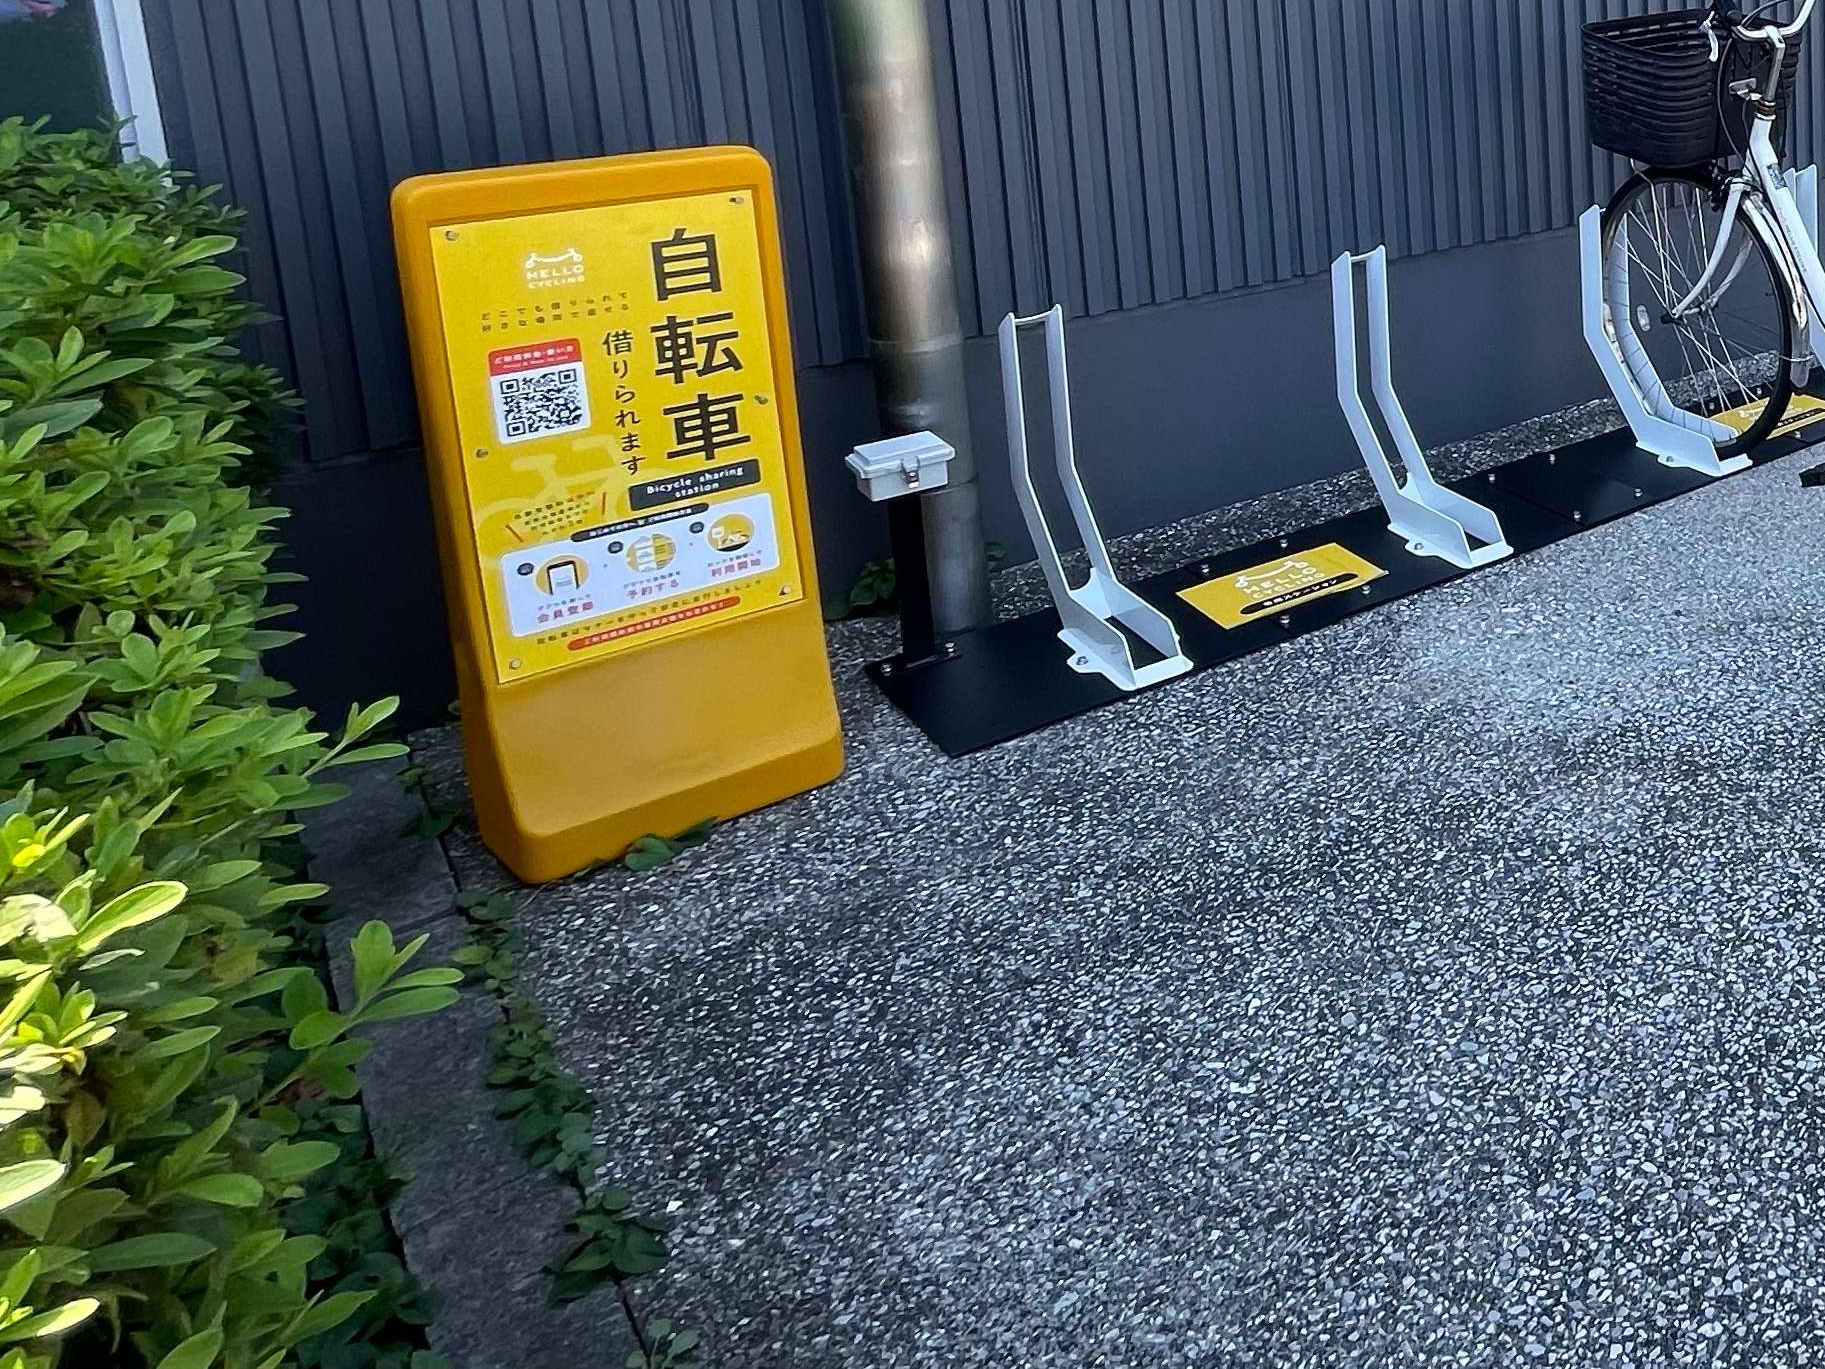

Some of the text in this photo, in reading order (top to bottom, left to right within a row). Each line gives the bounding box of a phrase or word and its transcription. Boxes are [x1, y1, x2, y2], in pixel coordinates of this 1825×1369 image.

[526, 264, 585, 281] HELLO
[528, 275, 585, 290] CYCLING
[650, 228, 751, 462] 自転車
[602, 330, 647, 476] 借りられます
[646, 465, 744, 495] Bicycle sharing
[674, 482, 720, 499] station
[1243, 567, 1317, 594] HELLO
[1252, 571, 1326, 598] CYCLING
